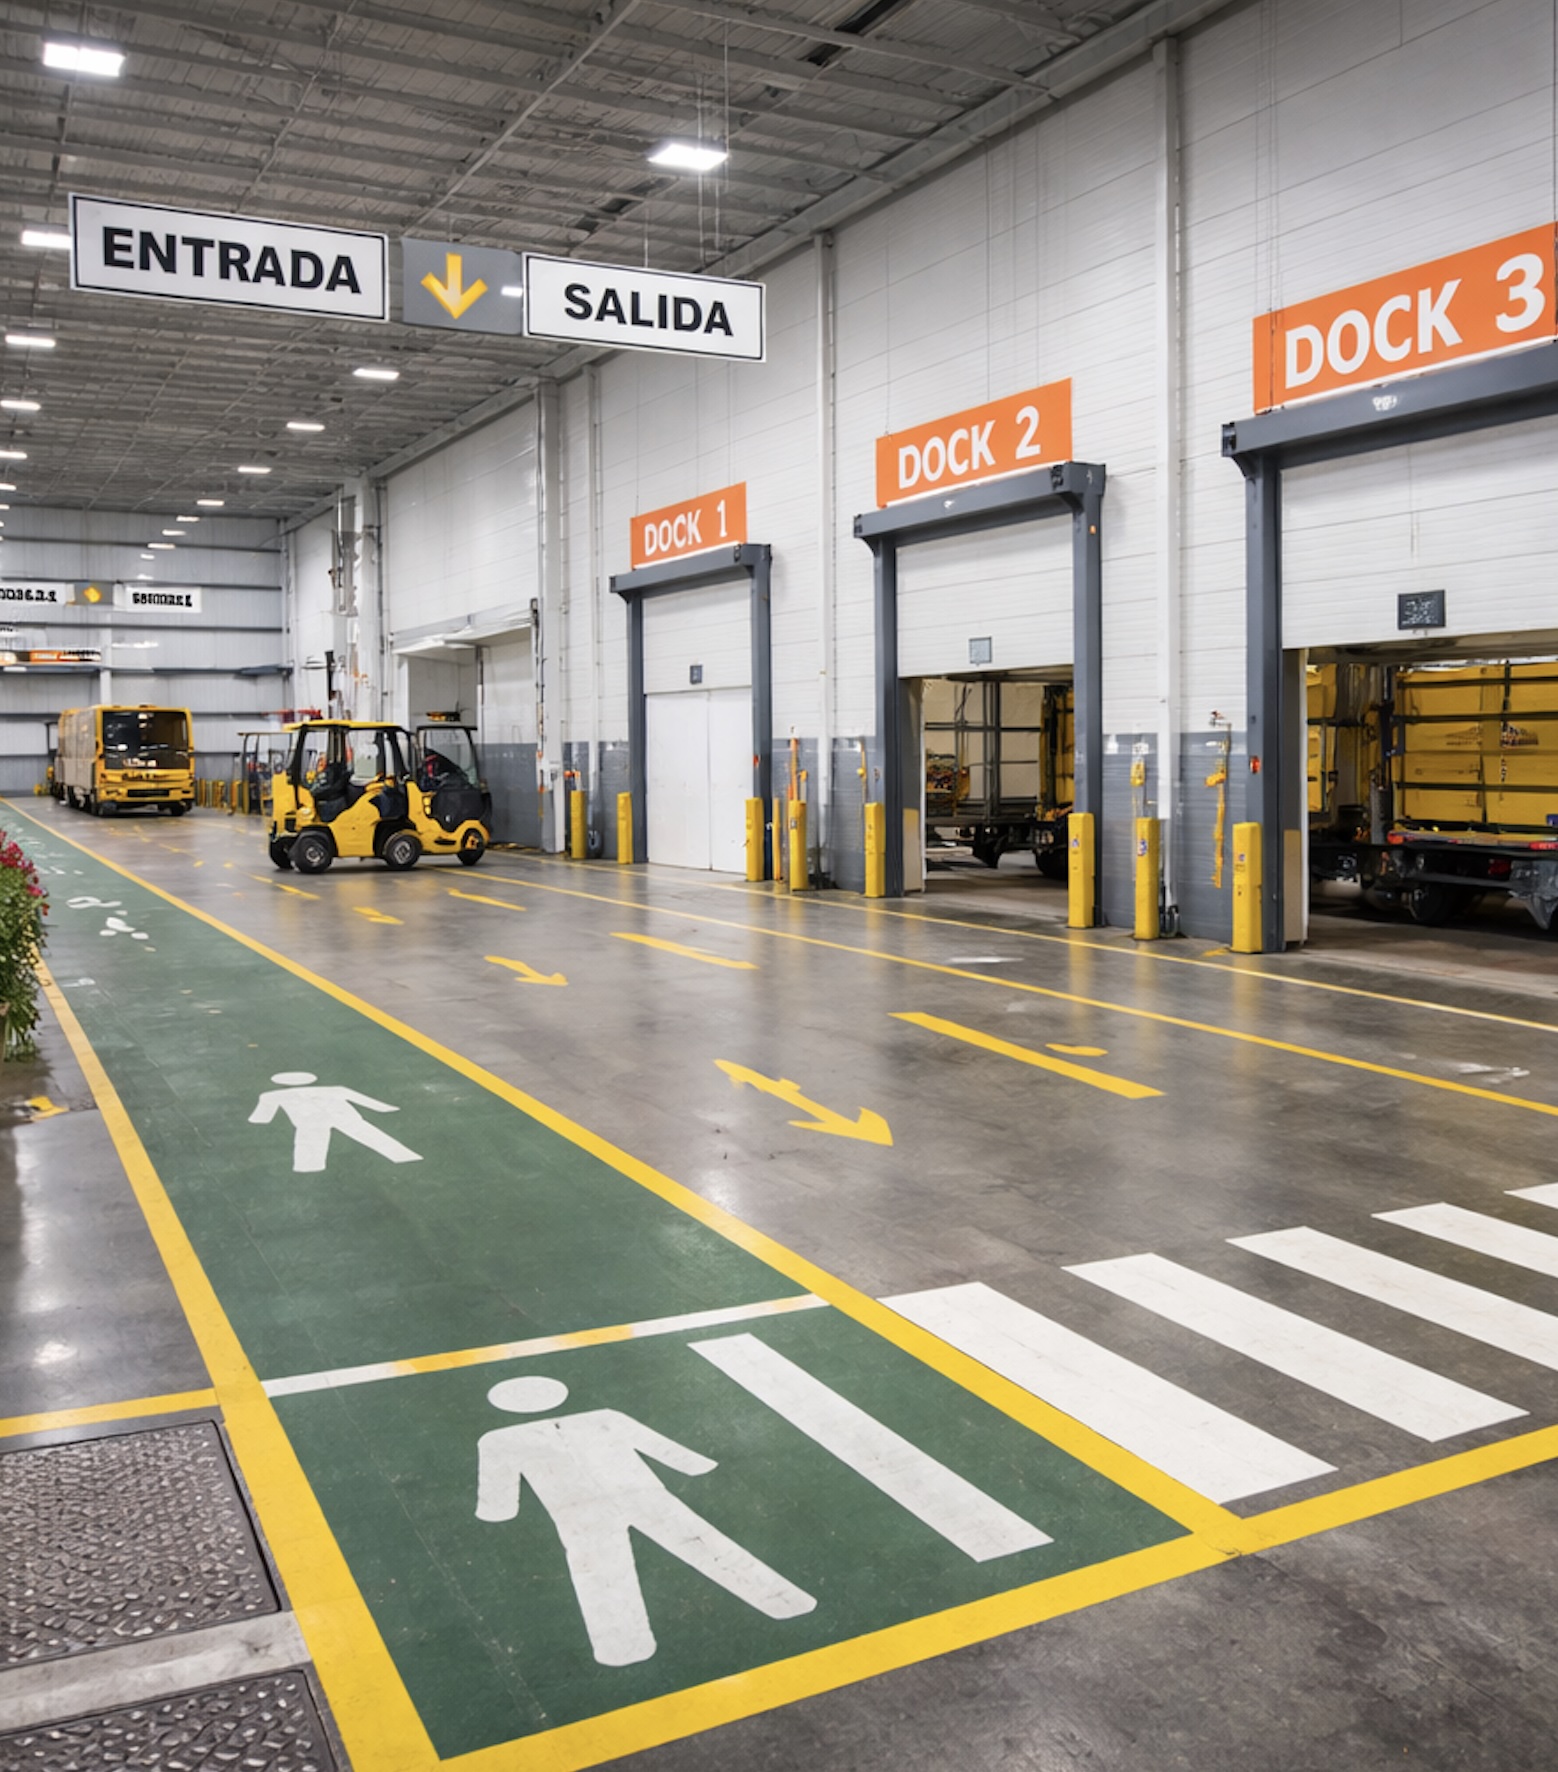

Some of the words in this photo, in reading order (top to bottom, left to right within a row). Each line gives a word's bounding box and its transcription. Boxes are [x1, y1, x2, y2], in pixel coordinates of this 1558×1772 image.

[102, 226, 362, 294] ENTRADA
[564, 283, 734, 337] SALIDA
[1284, 278, 1463, 389] DOCK
[1495, 253, 1546, 333] 3
[897, 420, 996, 490] DOCK
[1015, 405, 1042, 460] 2
[643, 509, 703, 557] DOCK
[716, 499, 729, 538] 1
